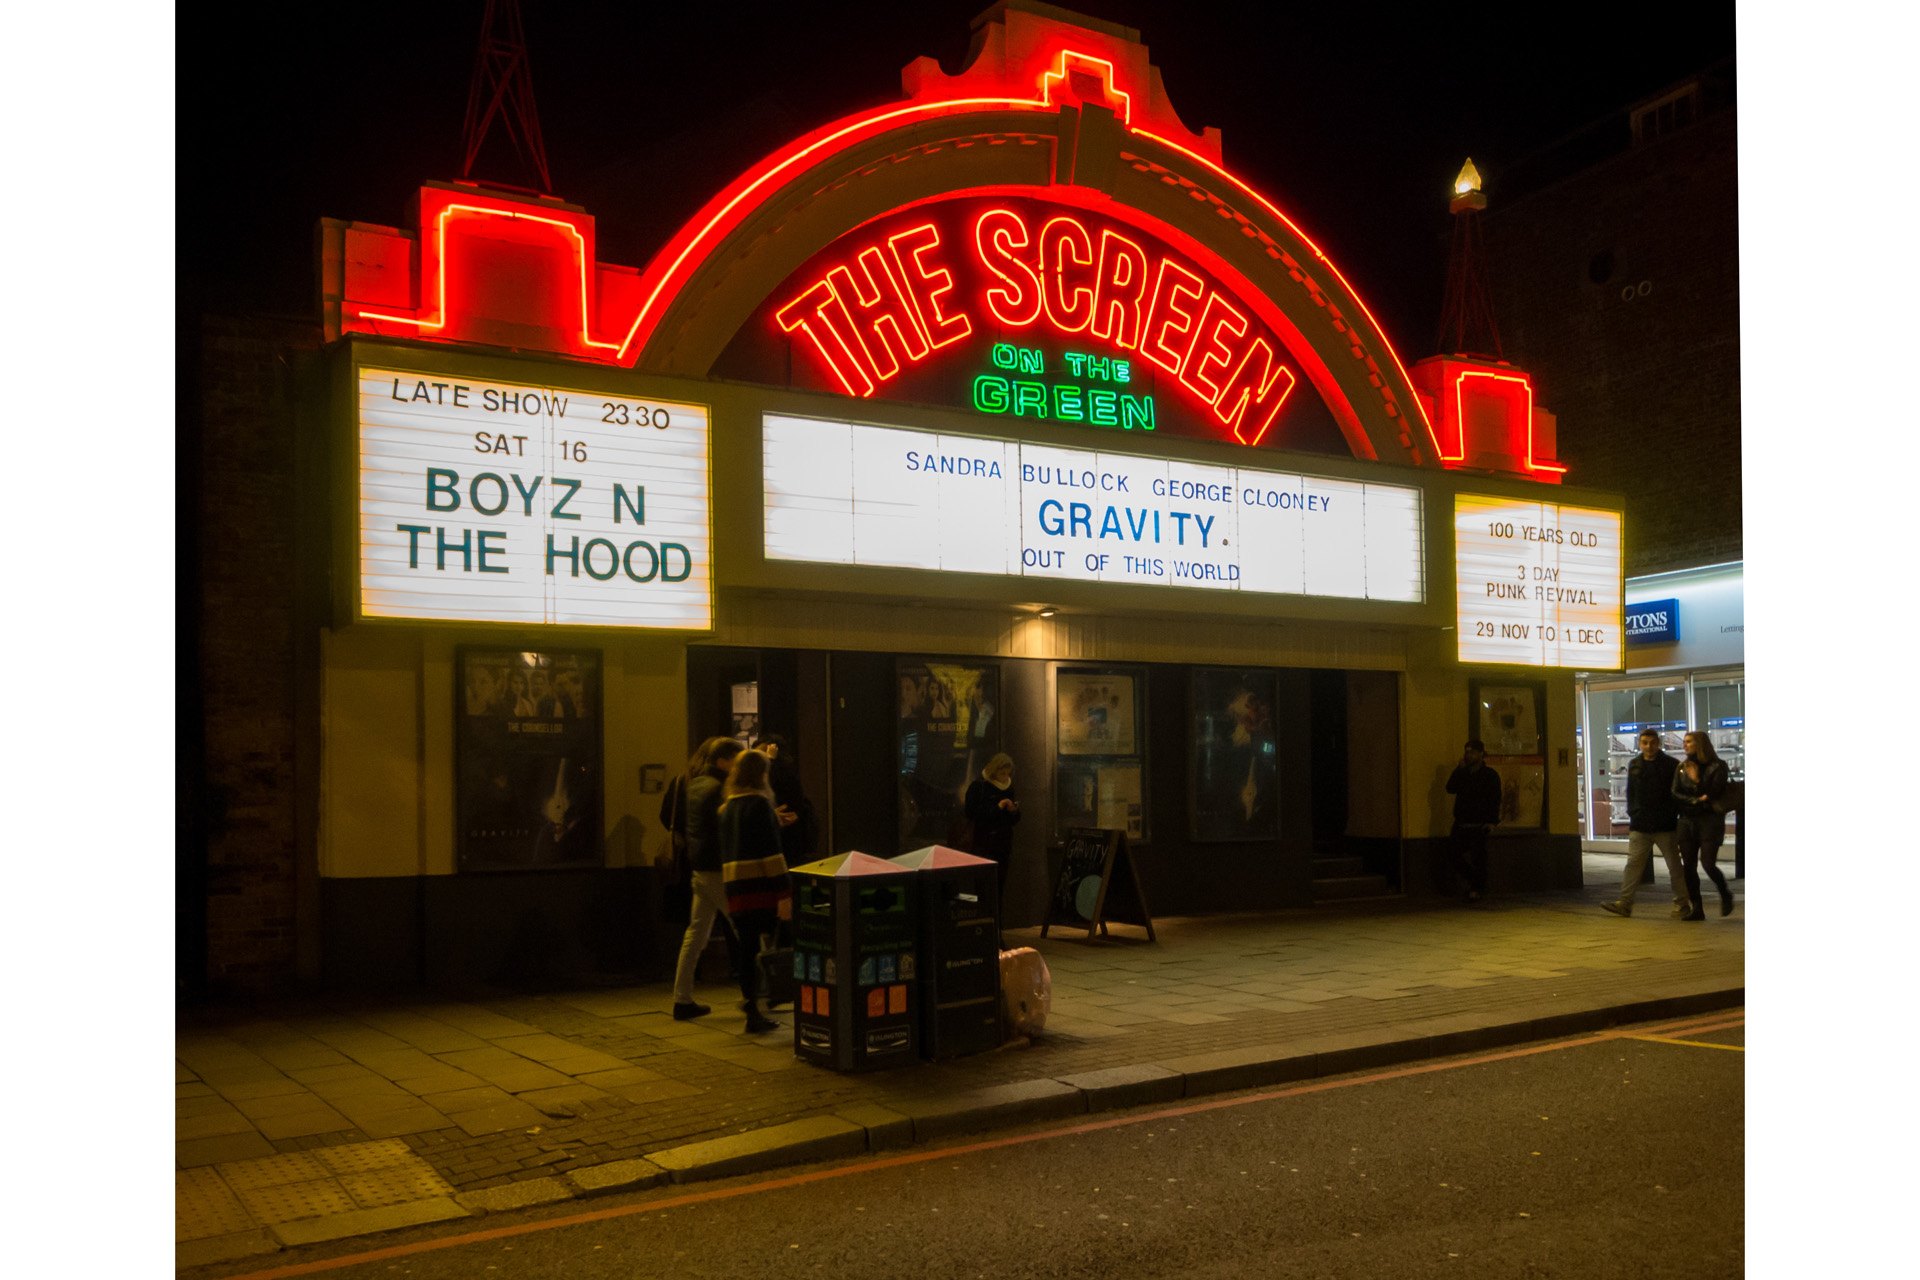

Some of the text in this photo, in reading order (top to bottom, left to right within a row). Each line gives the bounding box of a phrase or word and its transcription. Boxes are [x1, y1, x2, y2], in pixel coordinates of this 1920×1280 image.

[776, 208, 1295, 446] THE SCREEN
[991, 342, 1131, 383] ON THE
[391, 378, 470, 409] LATE
[482, 389, 568, 418] SHOW
[974, 375, 1156, 430] GREEN
[474, 431, 588, 463] SAT 16
[426, 467, 645, 526] BOYZ N
[906, 451, 1331, 513] SANDRA BULLOCK GEORGE CLOONEY
[397, 523, 692, 583] THE HOOD
[1488, 522, 1598, 548] 100 YEARS OLD
[1022, 548, 1241, 582] OUT OF THIS WORLD
[1517, 565, 1560, 582] 3 DAY
[1486, 582, 1598, 606] PUNK REVIVAL
[1476, 622, 1604, 644] 29 NOV TO 1 DEC
